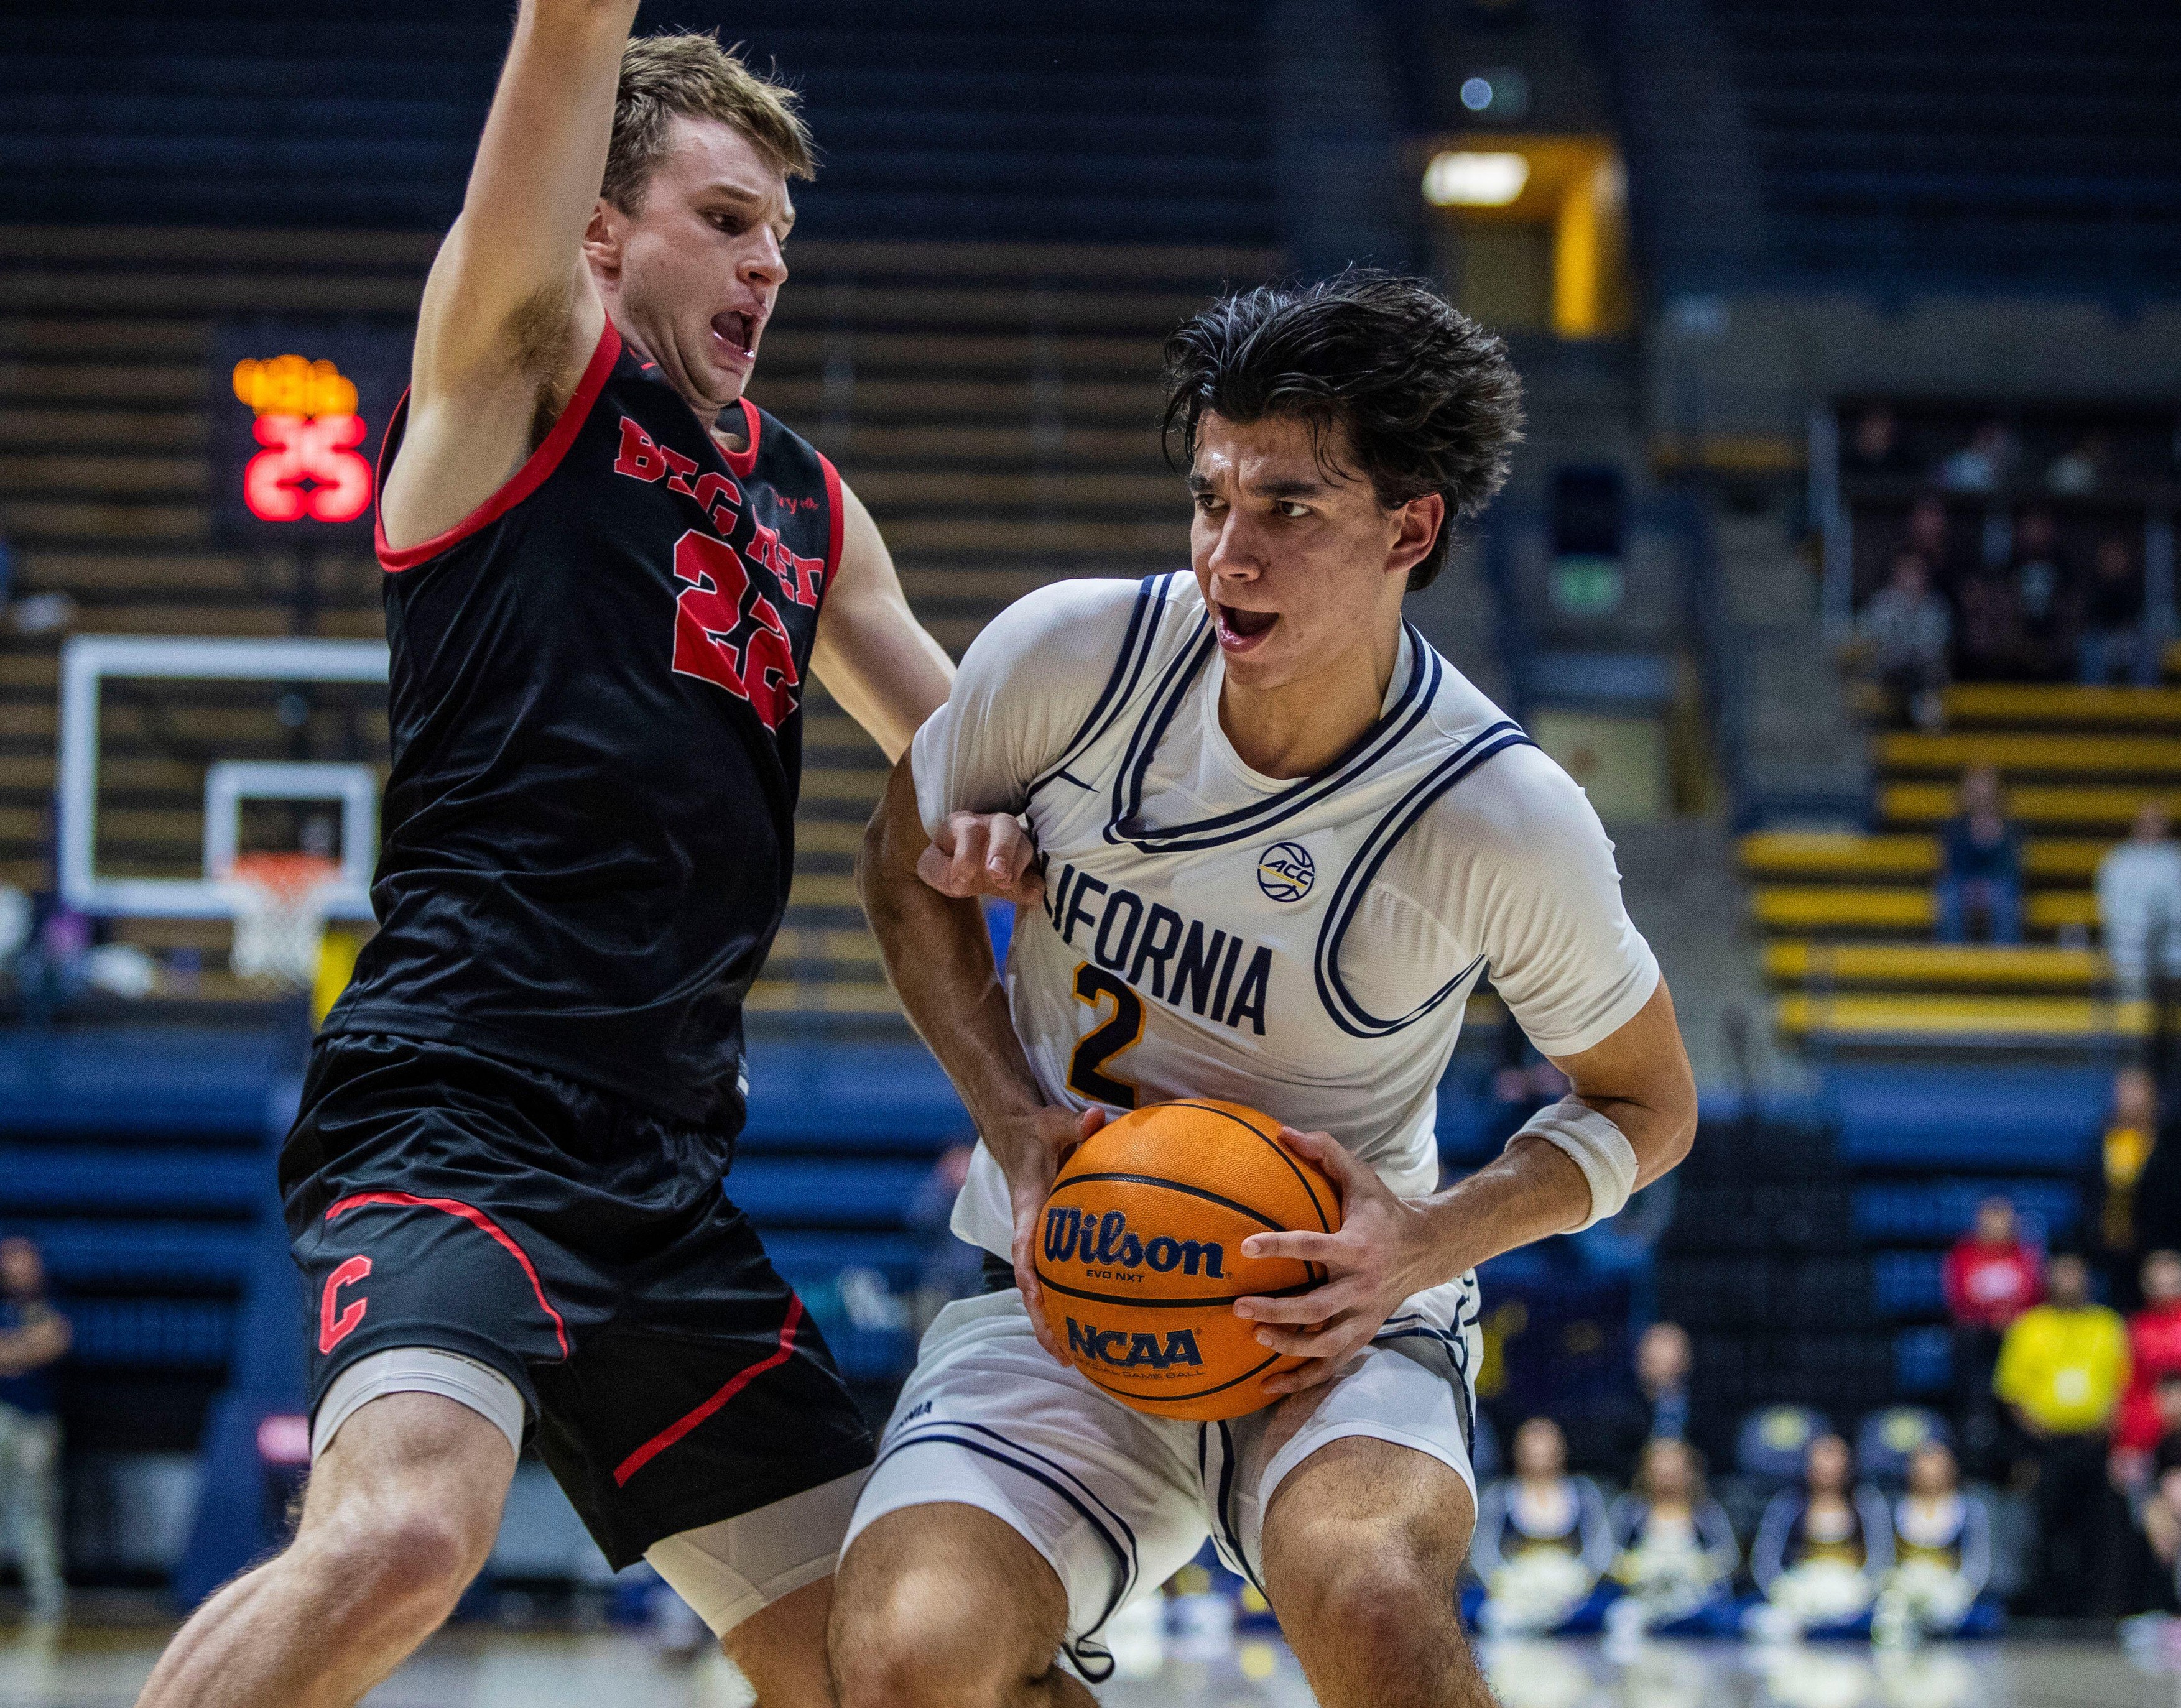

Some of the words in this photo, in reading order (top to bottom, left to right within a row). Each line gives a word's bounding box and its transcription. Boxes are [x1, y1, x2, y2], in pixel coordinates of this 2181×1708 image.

[614, 416, 741, 537] BIG
[1264, 859, 1315, 885] ACC
[1065, 961, 1147, 1109] 2
[1044, 1206, 1225, 1280] Wilson
[318, 1254, 373, 1355] C
[1086, 1269, 1111, 1280] EVO
[1115, 1272, 1145, 1283] NXT
[1066, 1316, 1205, 1370] NCAA
[1122, 1370, 1162, 1380] GAME
[1165, 1369, 1206, 1379] BALL
